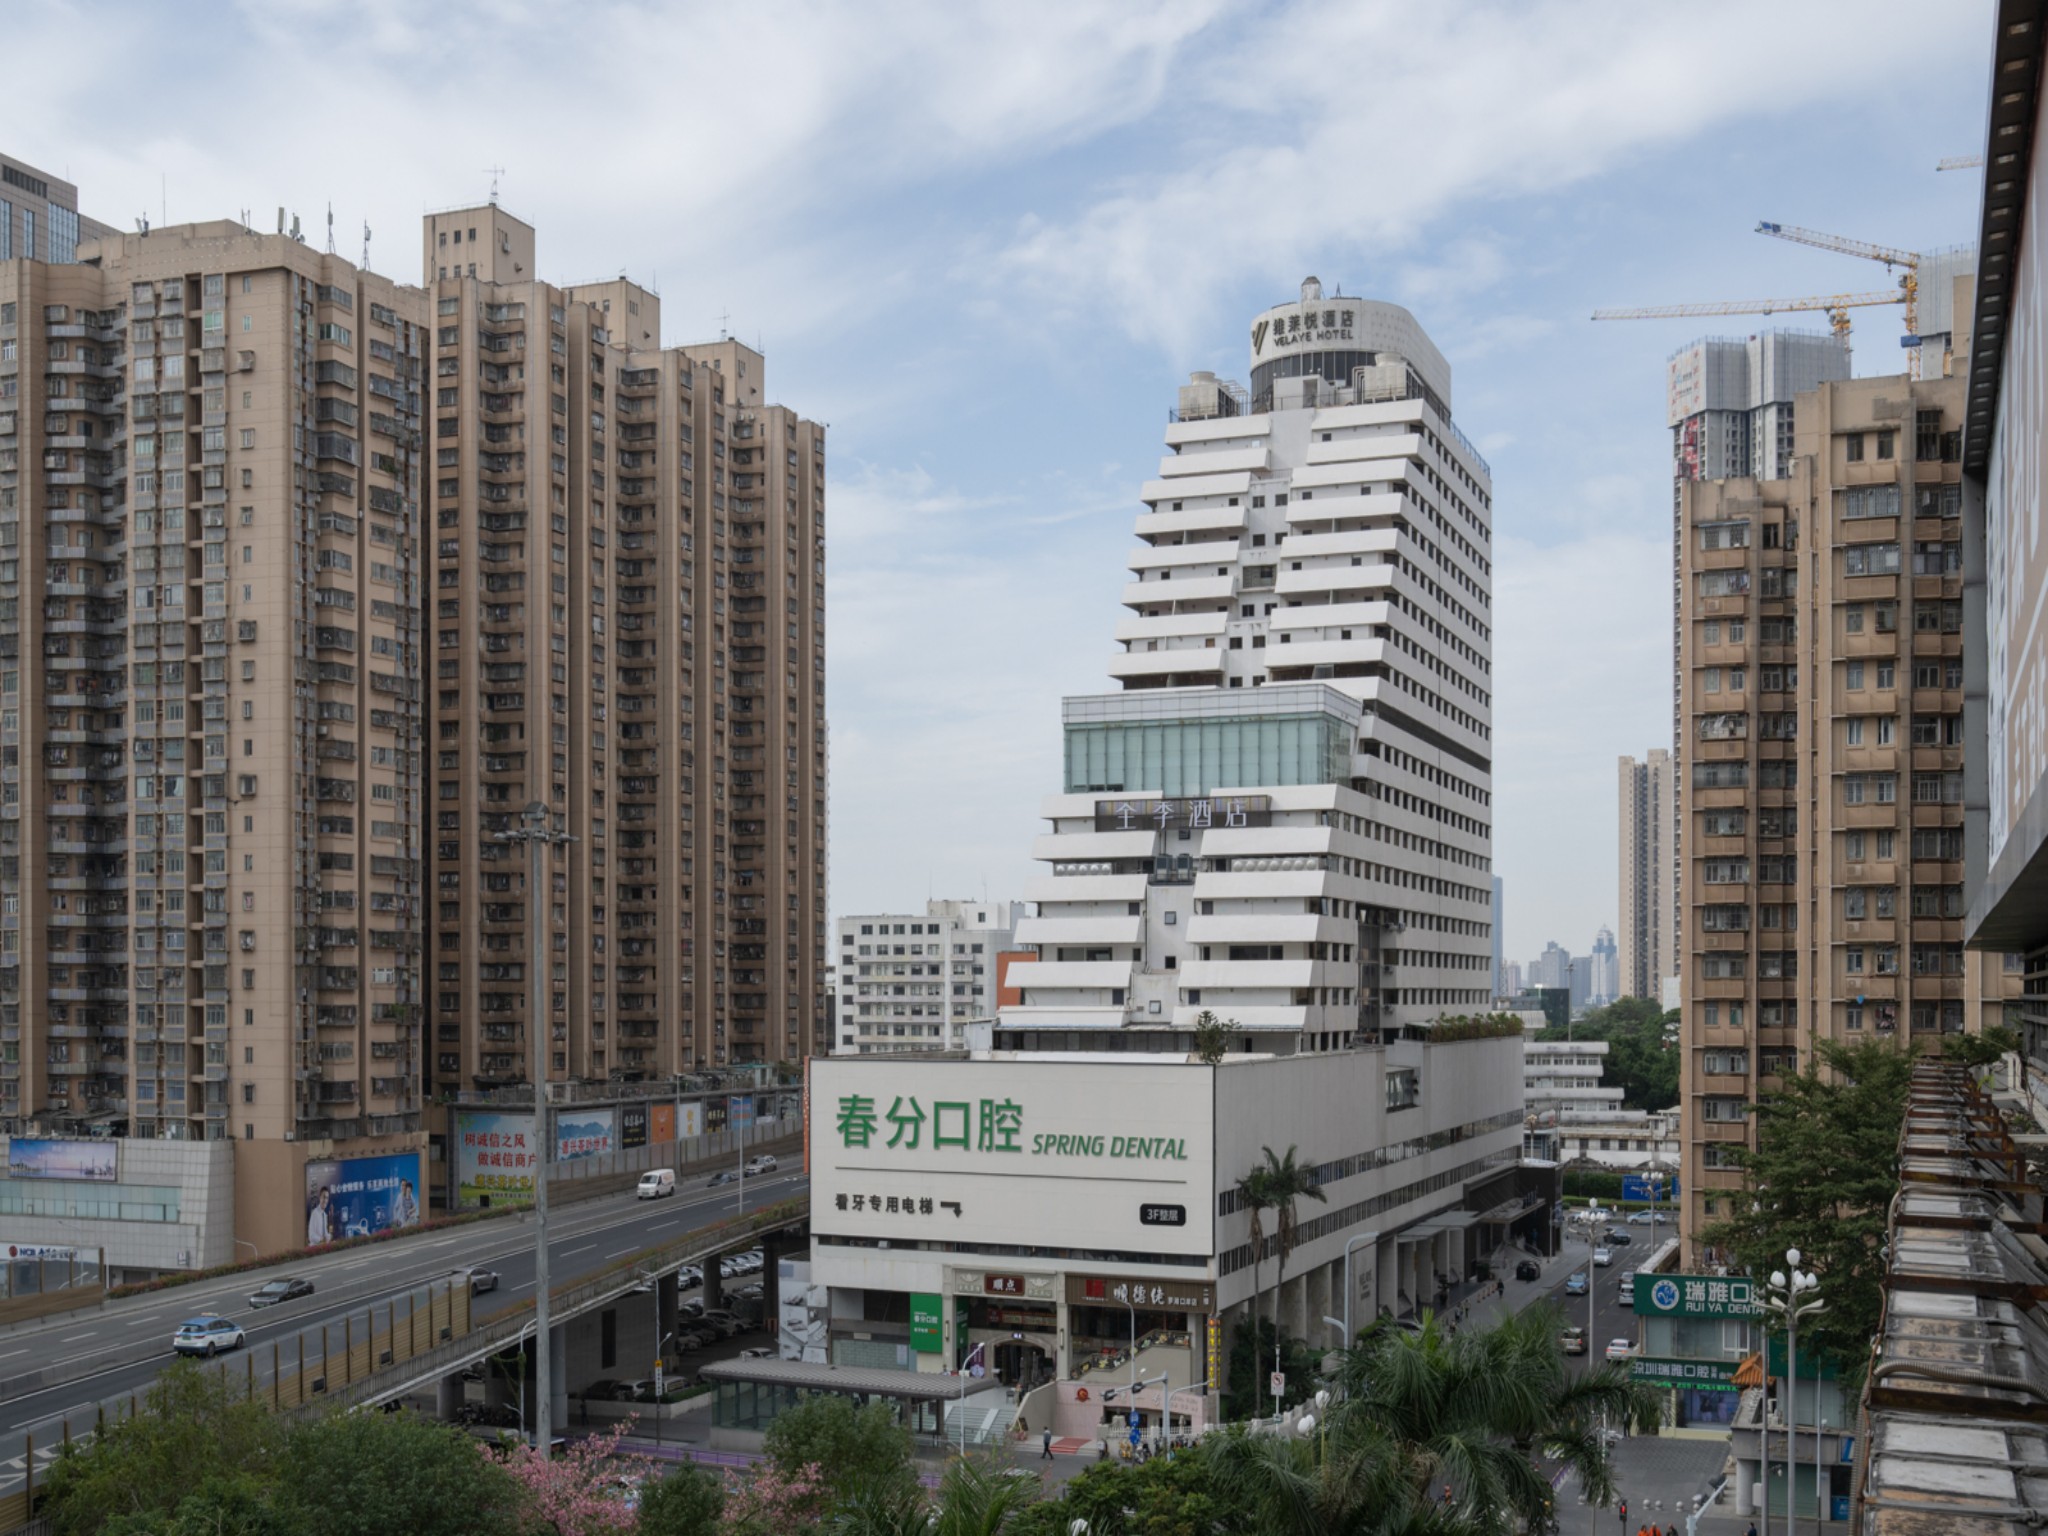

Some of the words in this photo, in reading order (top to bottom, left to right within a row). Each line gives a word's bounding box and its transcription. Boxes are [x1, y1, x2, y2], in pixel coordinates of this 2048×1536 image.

[1273, 331, 1312, 347] VELAYE
[1317, 329, 1354, 341] HOTEL
[1115, 799, 1247, 830] 全季酒店
[835, 1093, 1024, 1154] 春分口腔
[464, 1131, 526, 1148] 树诚信之风
[1032, 1133, 1105, 1157] SPRING
[1110, 1136, 1188, 1160] DENTAL
[834, 1192, 935, 1215] 看牙专用电梯
[1146, 1208, 1179, 1222] 3F整层
[1685, 1302, 1705, 1313] RUI
[1708, 1303, 1723, 1313] YA
[1728, 1304, 1764, 1315] DENTA
